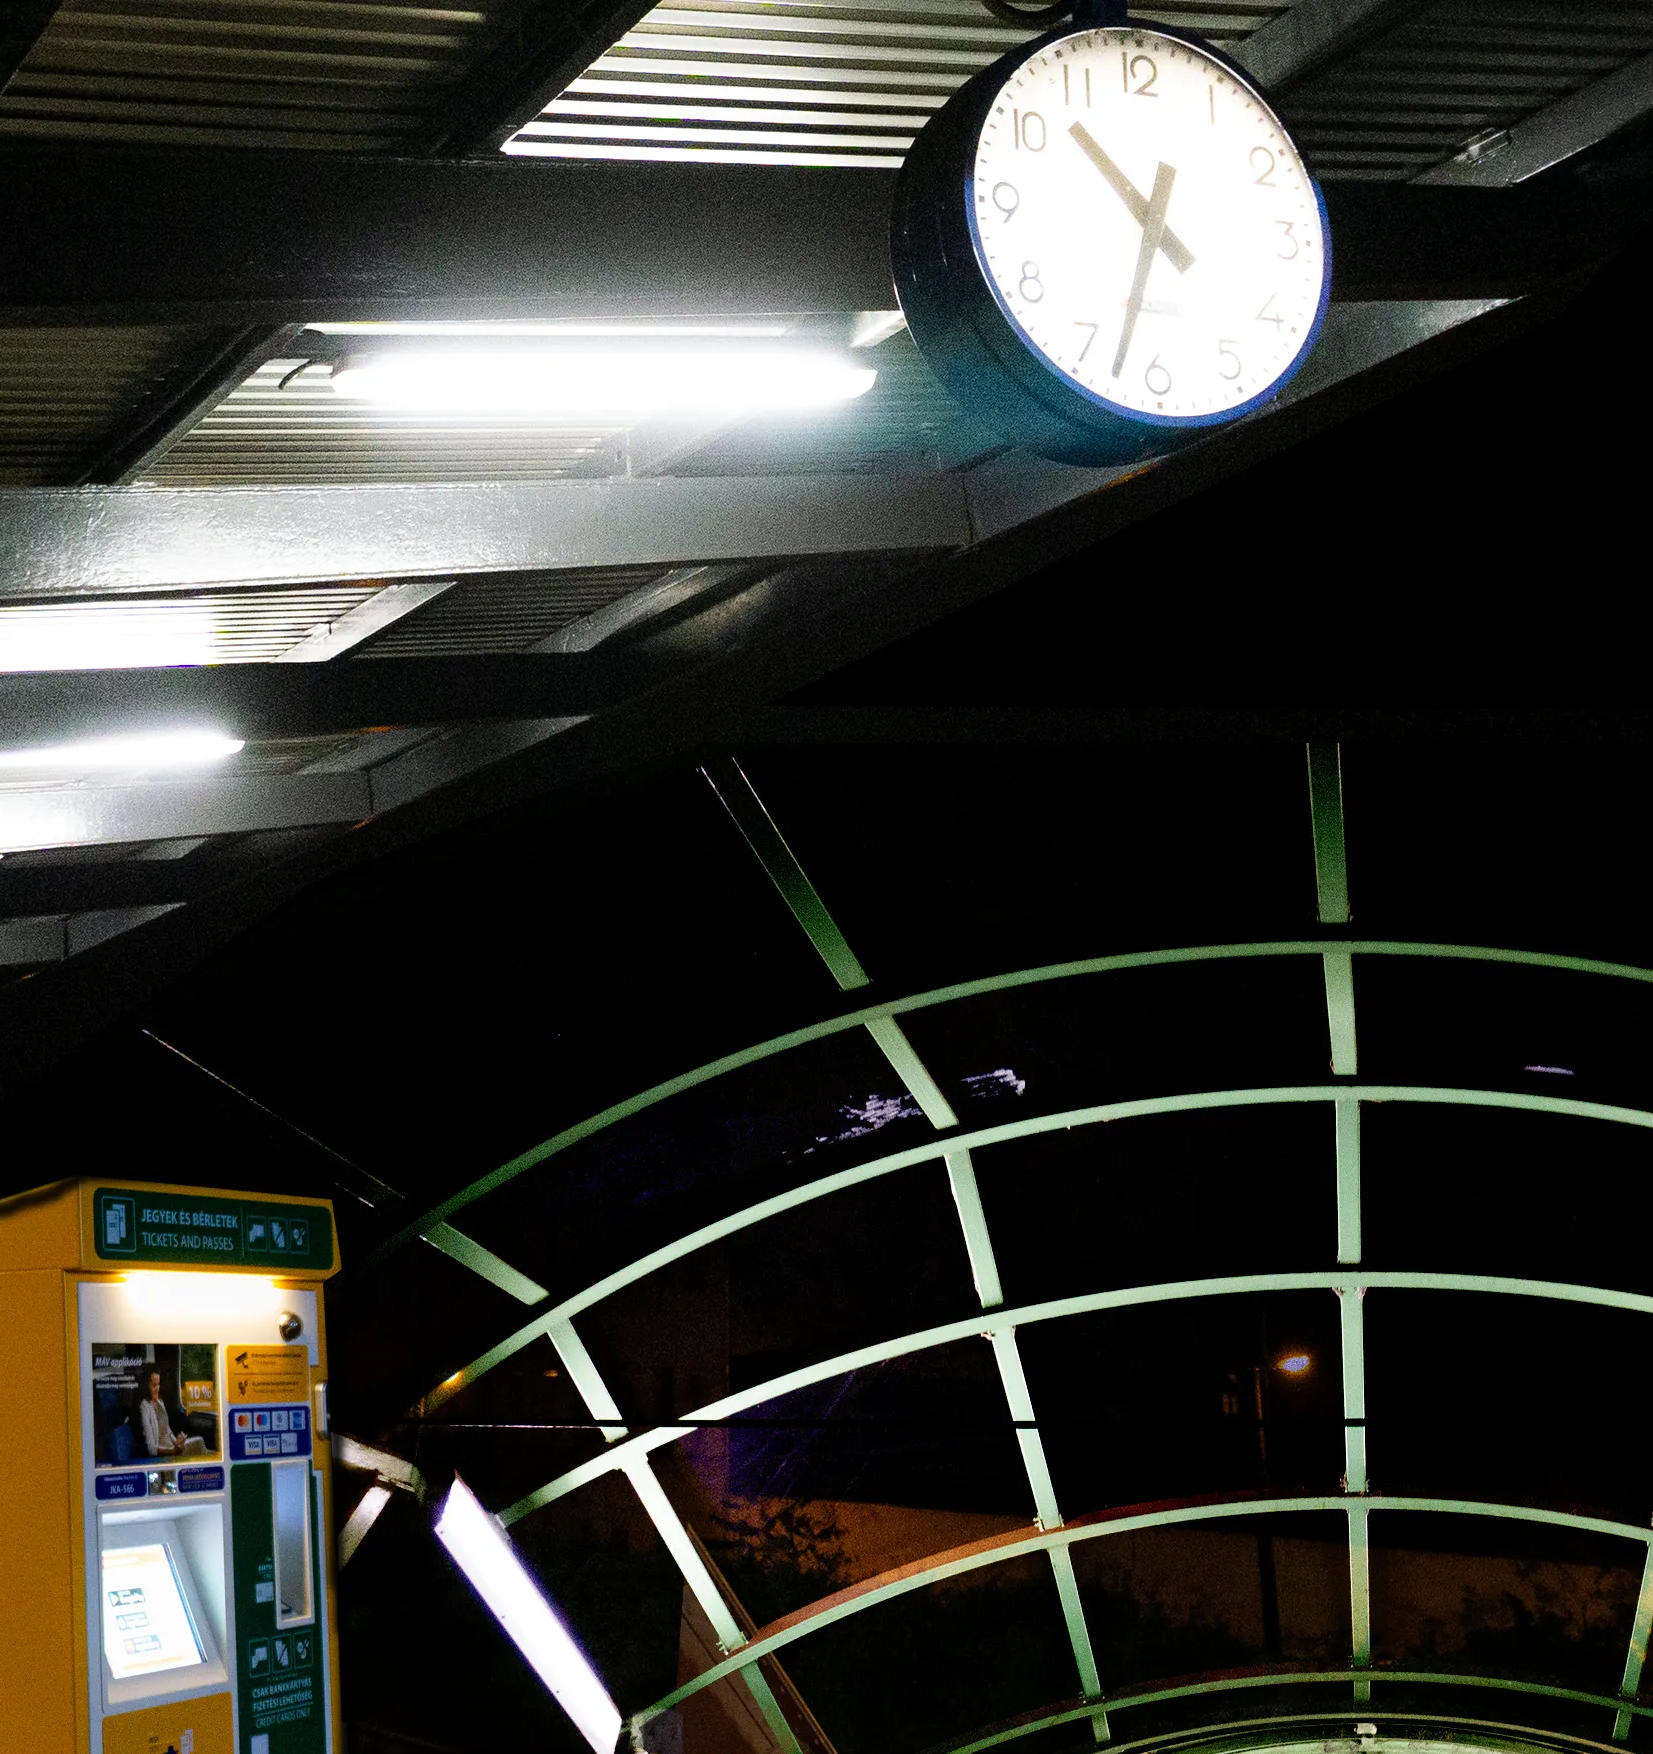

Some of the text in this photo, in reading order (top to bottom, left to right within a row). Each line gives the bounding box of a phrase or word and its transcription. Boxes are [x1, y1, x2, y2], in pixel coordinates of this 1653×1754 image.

[1064, 64, 1091, 108] 11
[1122, 52, 1158, 97] 12
[1013, 108, 1047, 152] 10
[1249, 145, 1276, 187] 2
[992, 181, 1020, 223] 9
[1276, 220, 1299, 260] 3
[1018, 260, 1044, 303] 8
[1257, 291, 1284, 331] 4
[1074, 320, 1099, 362] 7
[1218, 339, 1241, 380] 5
[1144, 354, 1172, 396] 6
[141, 1209, 238, 1229] JEGYEK ÉS BÉRLETEK
[142, 1232, 234, 1251] TICKETS AND PASSES
[188, 1386, 200, 1399] 10
[252, 1687, 269, 1699] CSAK
[253, 1697, 279, 1712] FIZETÉSI
